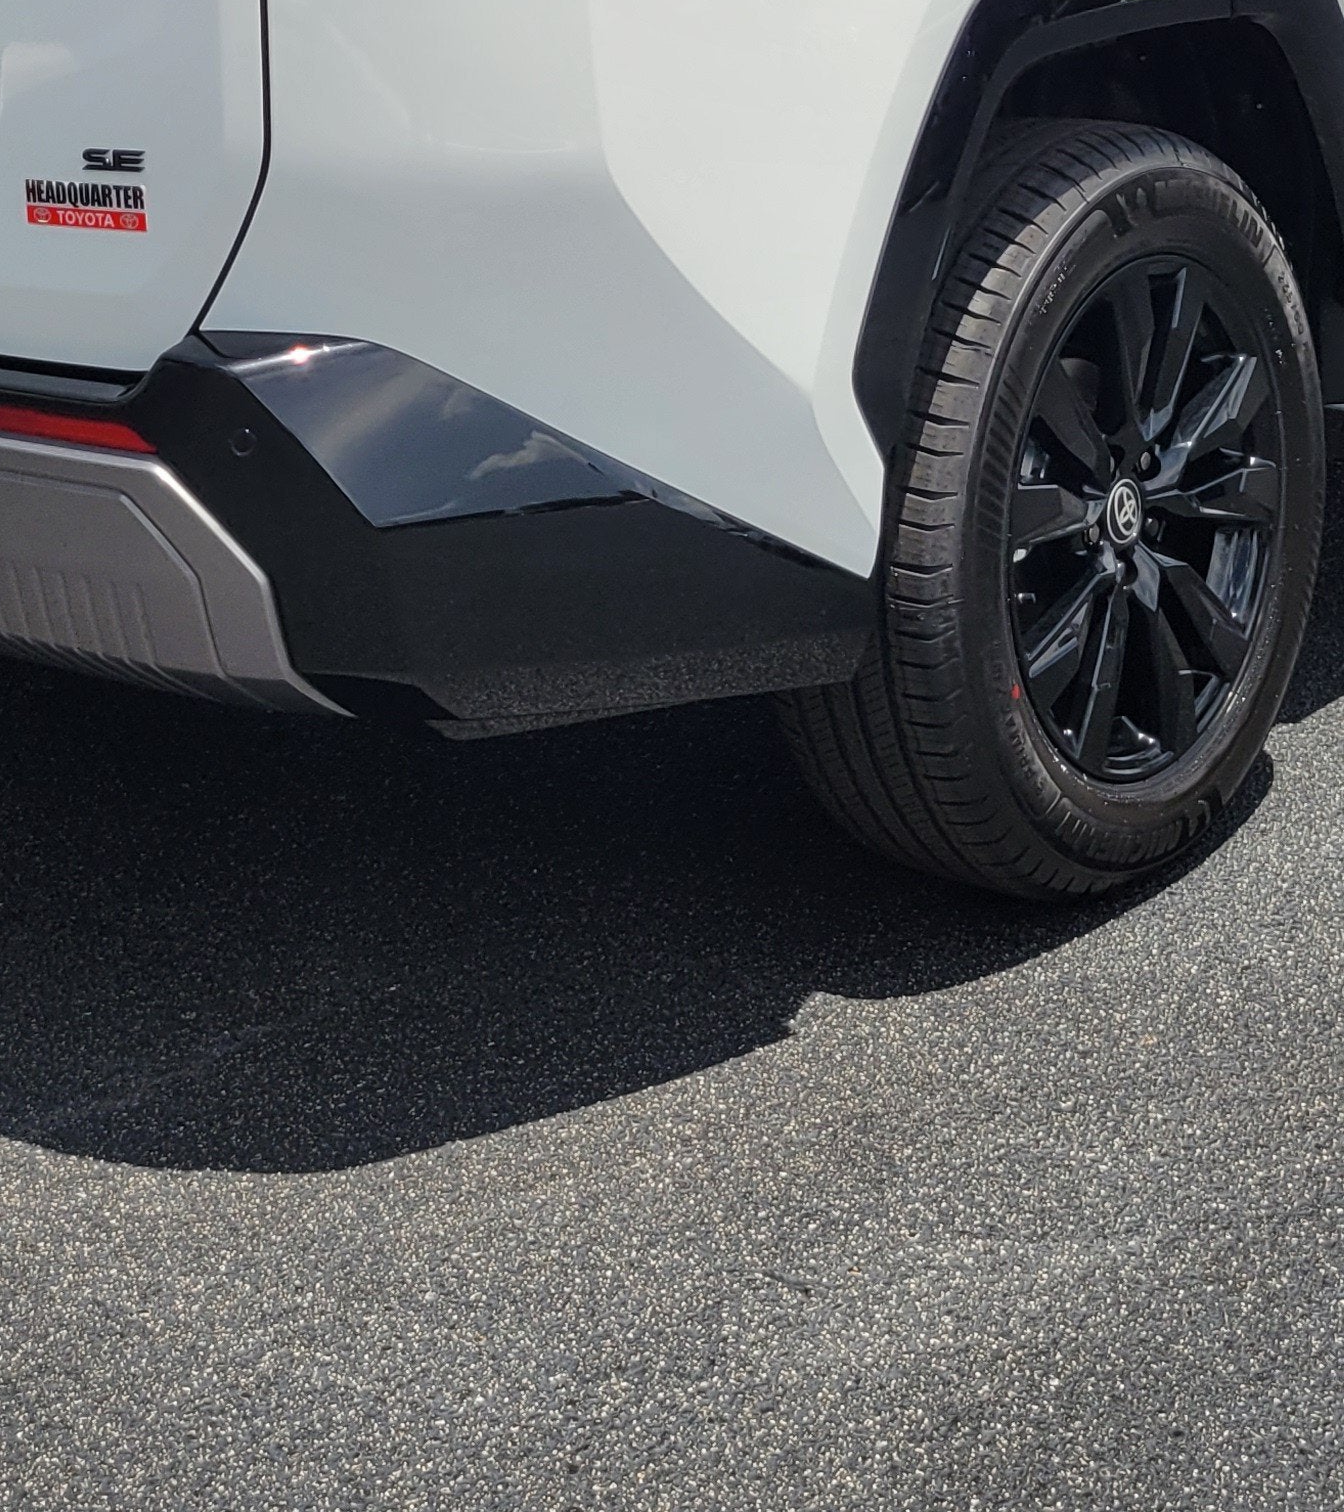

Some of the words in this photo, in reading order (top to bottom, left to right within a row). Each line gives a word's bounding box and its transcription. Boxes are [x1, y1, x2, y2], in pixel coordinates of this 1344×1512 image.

[82, 148, 146, 172] SE
[25, 179, 145, 209] HEADQUARTER
[57, 210, 114, 227] TOYOTA
